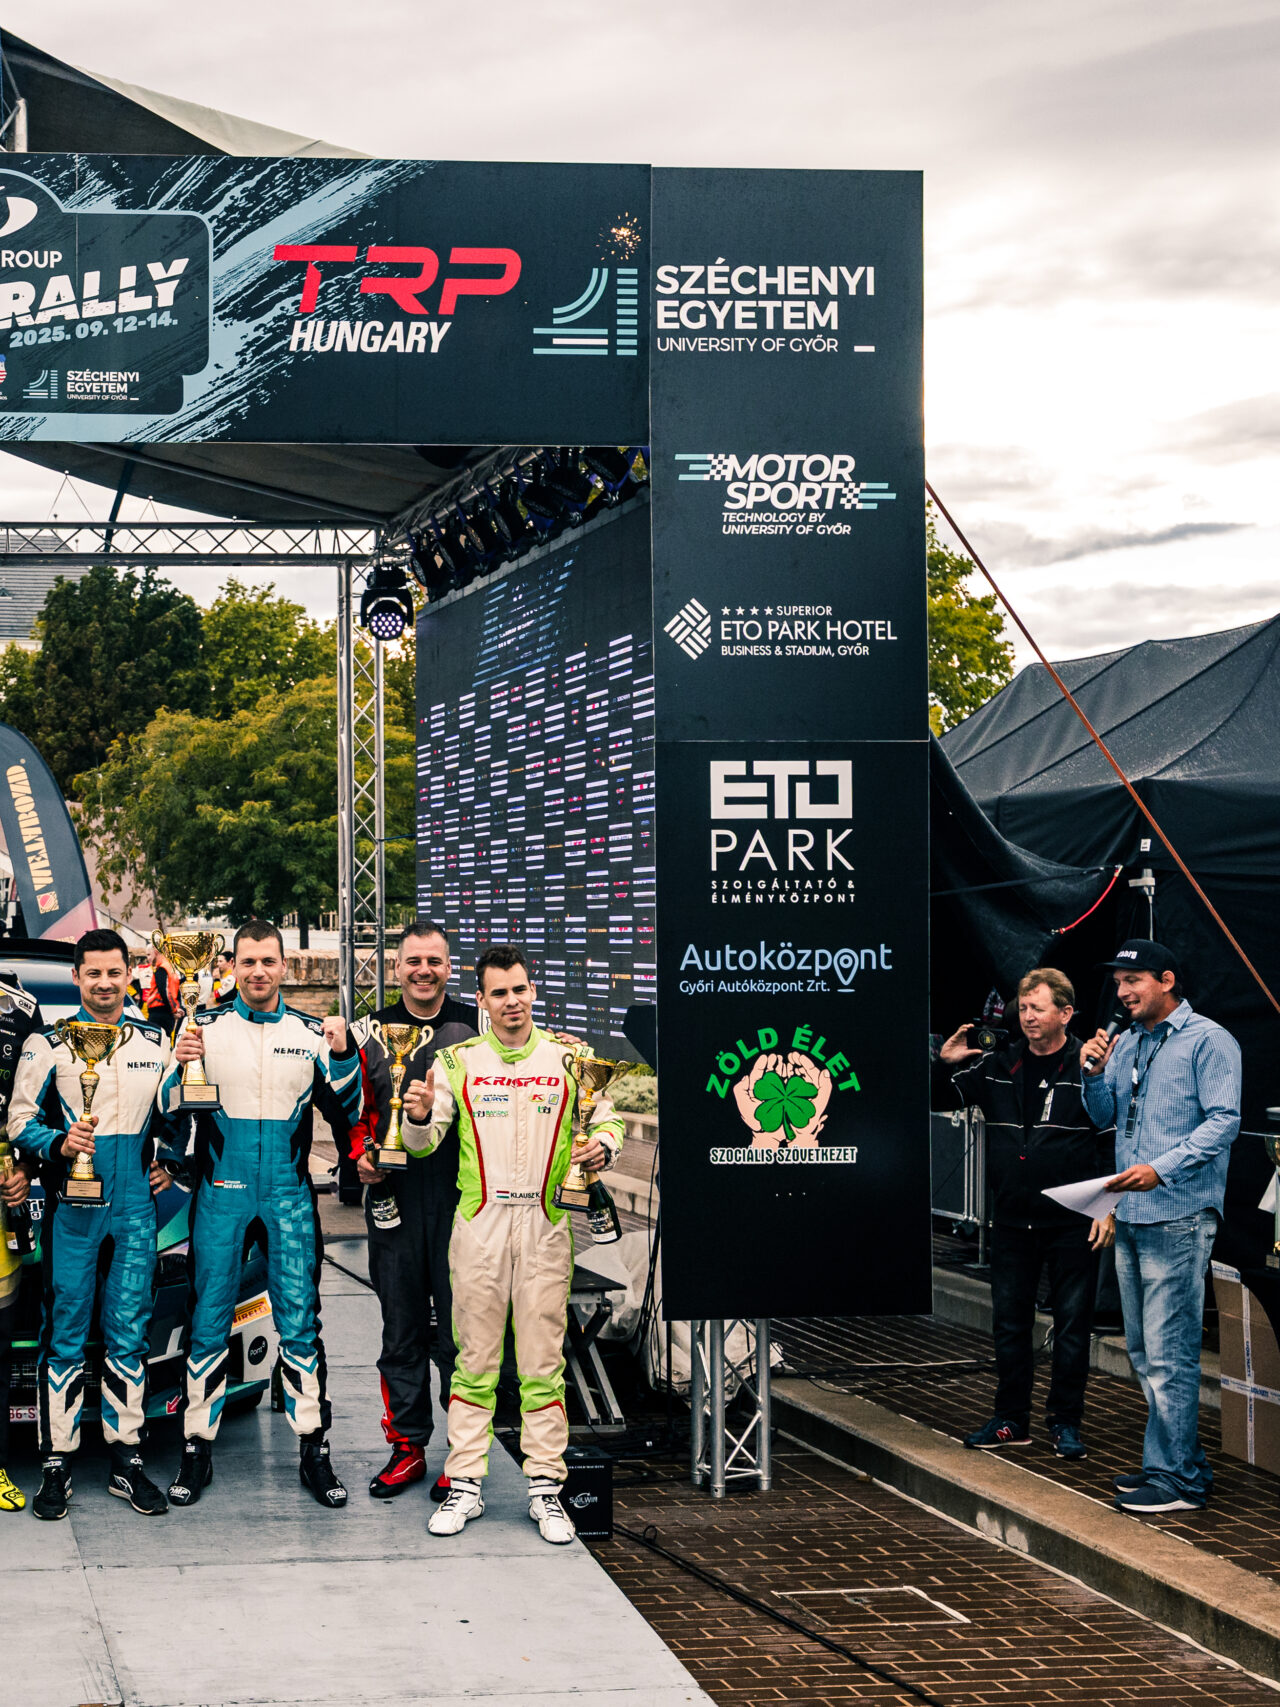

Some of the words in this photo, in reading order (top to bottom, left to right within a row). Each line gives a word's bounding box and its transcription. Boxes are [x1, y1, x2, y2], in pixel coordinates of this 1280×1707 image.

[273, 245, 522, 315] TRP
[655, 257, 875, 297] SZÉCHENYI
[656, 300, 839, 330] EGYETEM
[9, 326, 71, 348] 2025.
[75, 321, 108, 339] 09.
[115, 309, 178, 334] 12-14.
[289, 320, 452, 353] HUNGARY
[656, 336, 757, 354] UNIVERSITY
[761, 337, 785, 354] OF
[789, 332, 839, 354] GYŐR
[66, 369, 139, 383] SZÉCHENYI
[67, 382, 128, 393] EGYETEM
[724, 453, 856, 482] MOTOR
[724, 481, 844, 510] SPORT
[722, 512, 806, 523] TECHNOLOGY
[808, 512, 826, 523] BY
[722, 524, 793, 535] UNIVERSITY
[795, 524, 814, 535] OF
[816, 521, 852, 535] GYŐR
[776, 606, 833, 616] SUPERIOR
[720, 620, 762, 641] ETO
[768, 620, 821, 641] PARK
[825, 620, 898, 641] HOTEL
[721, 645, 771, 656] BUSINESS
[774, 645, 783, 656] &
[785, 645, 835, 657] STADIUM,
[837, 642, 869, 656] GYŐR
[710, 760, 853, 819] ETO
[6, 764, 54, 891] METABOND
[711, 828, 855, 871] PARK
[711, 877, 837, 890] SZOLGÁLTATÓ
[847, 880, 855, 889] &
[711, 892, 855, 904] ÉLMÉNYKÖZPONT
[679, 940, 893, 986] Autoközpont
[679, 979, 714, 995] Győri
[717, 979, 803, 995] Autóközpont
[806, 979, 830, 992] Zrt.
[705, 1026, 779, 1099] ZÖLD
[791, 1023, 861, 1094] ÉLET
[710, 1145, 774, 1164] SZOCIÁLIS
[776, 1145, 858, 1164] SZÖVETKEZET
